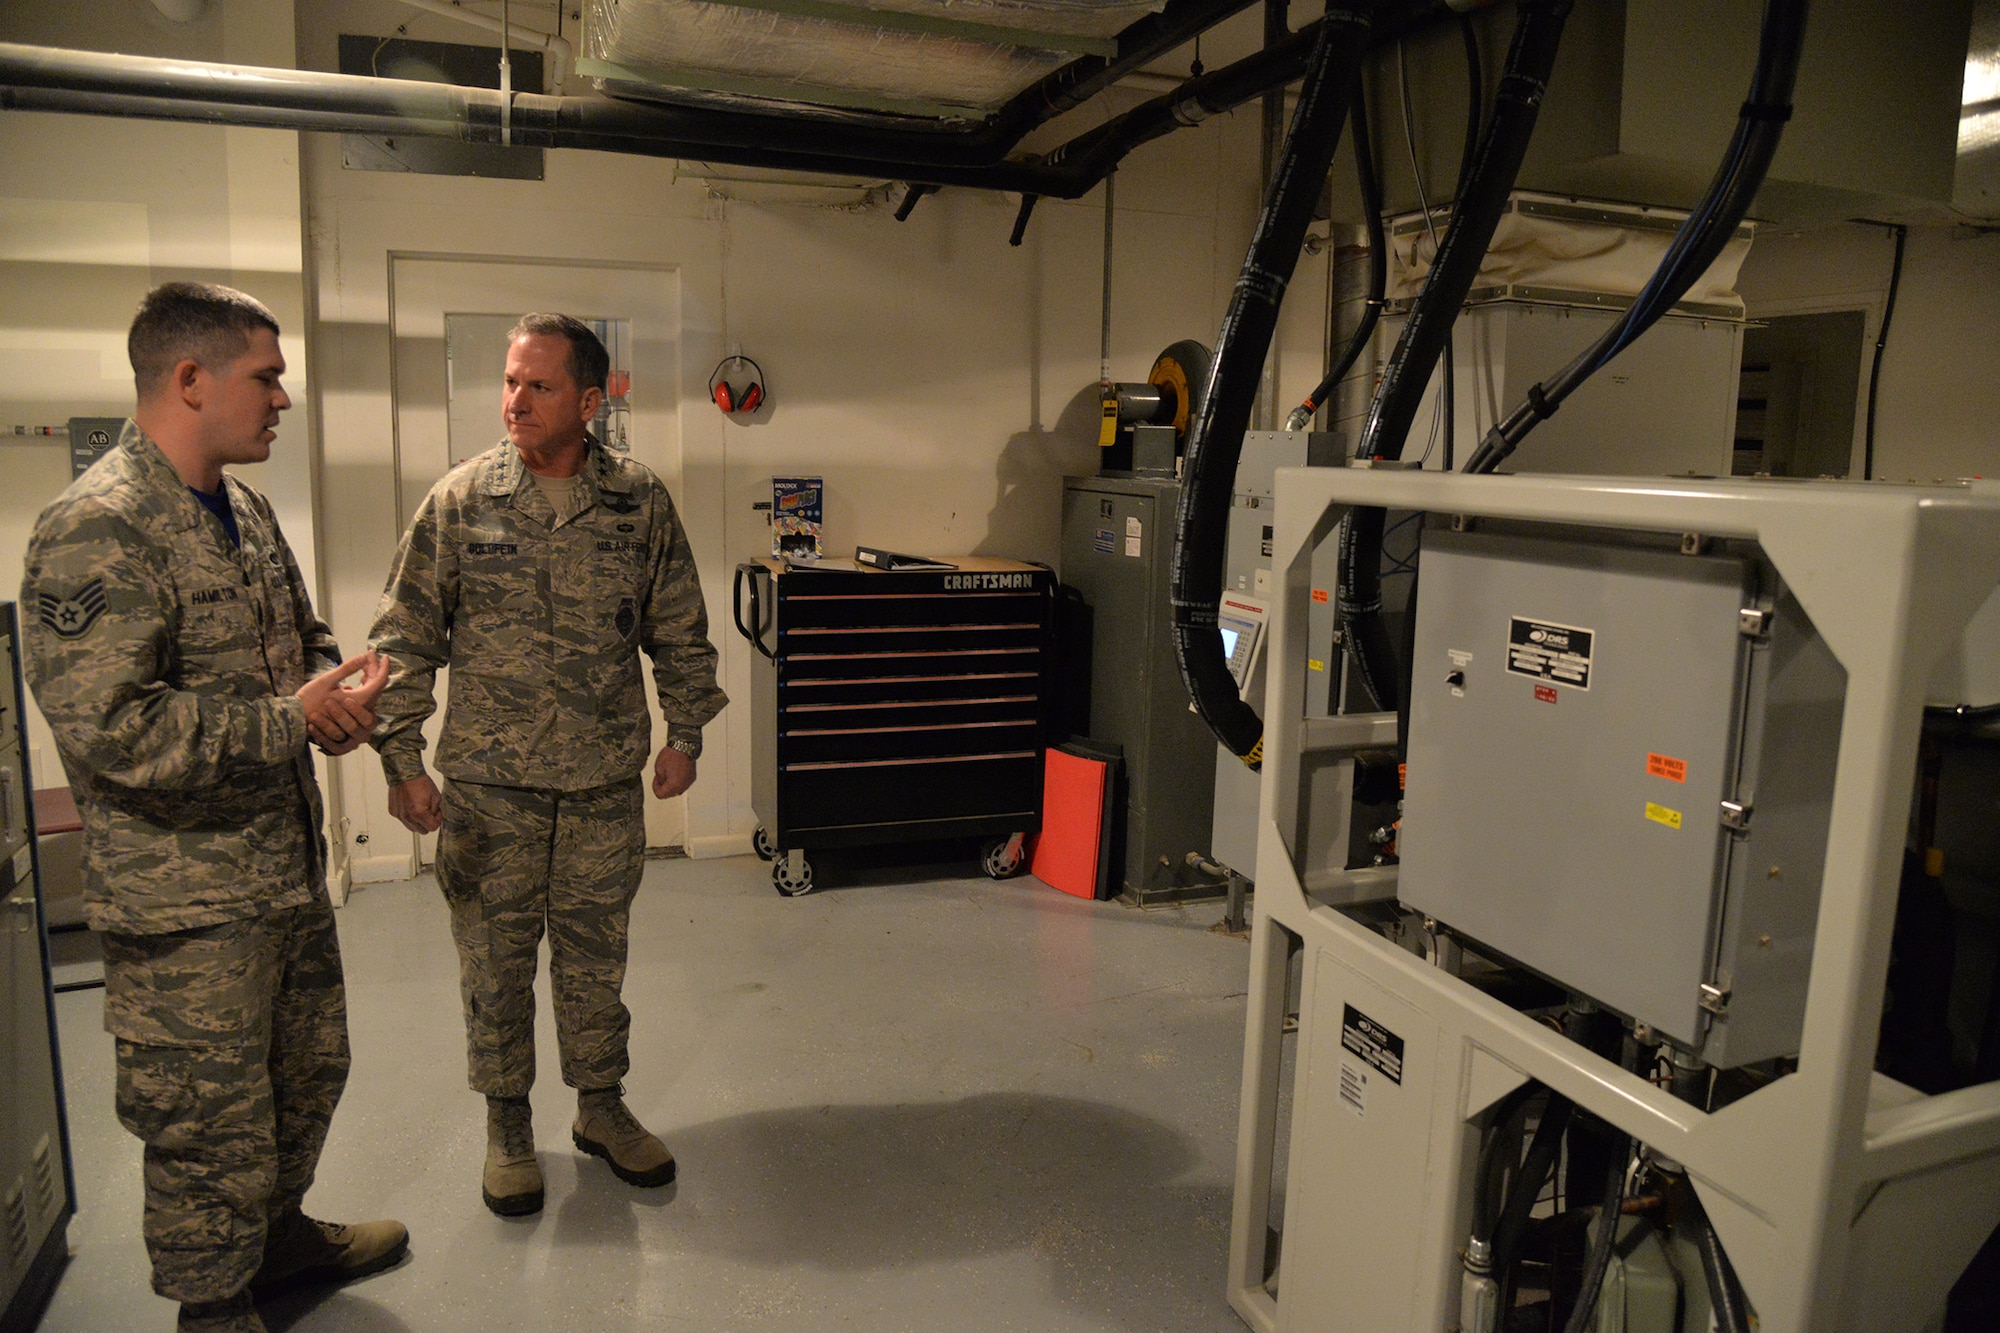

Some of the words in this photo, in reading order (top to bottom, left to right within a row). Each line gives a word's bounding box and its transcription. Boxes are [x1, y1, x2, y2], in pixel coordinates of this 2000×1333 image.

[90, 433, 108, 444] AB
[614, 541, 630, 551] AIR
[943, 573, 1033, 590] CRAFTSMAN
[191, 586, 238, 605] HAMILTON
[1546, 633, 1569, 646] DRS
